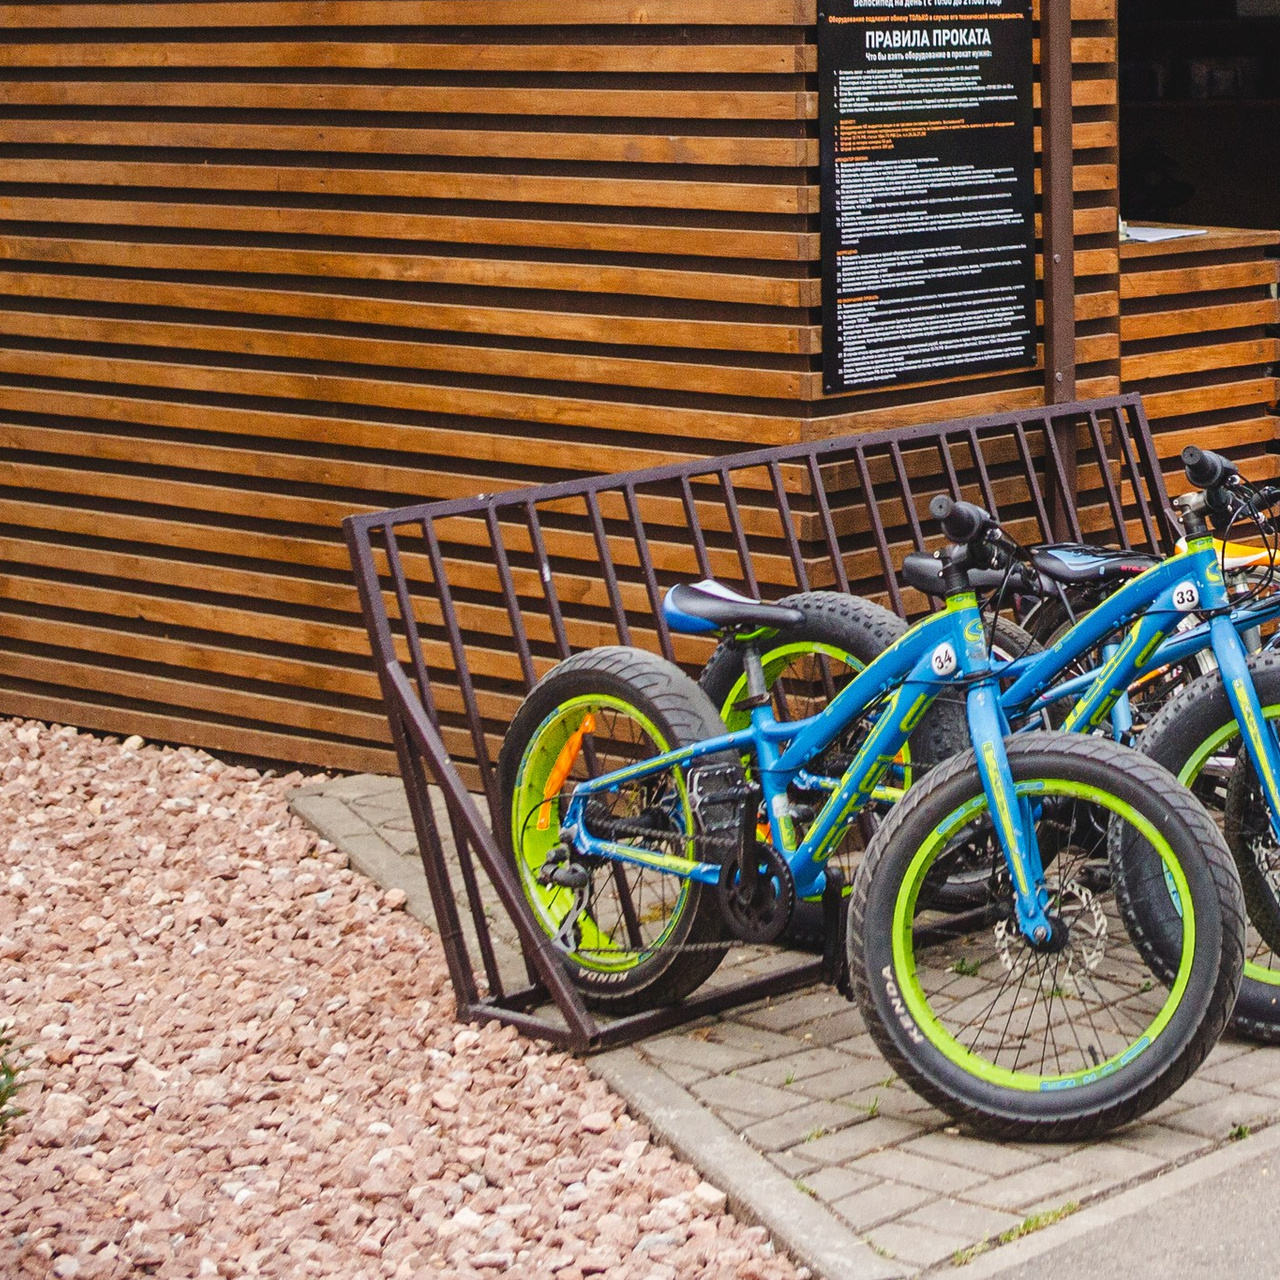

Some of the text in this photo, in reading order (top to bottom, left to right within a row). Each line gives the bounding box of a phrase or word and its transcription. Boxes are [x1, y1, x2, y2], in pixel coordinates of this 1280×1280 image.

[828, 16, 865, 24] Оборудование
[909, 14, 929, 22] ТОЛЬКО
[866, 28, 992, 49] ПРАВИЛА ПРОКАТА
[866, 52, 876, 61] Что
[878, 52, 887, 61] бы
[888, 52, 904, 60] взять
[905, 51, 946, 61] оборудование
[952, 50, 971, 60] прокат
[1176, 589, 1195, 605] 33
[934, 651, 953, 669] 34
[578, 967, 629, 983] KENDA
[882, 964, 924, 1044] KENDA
